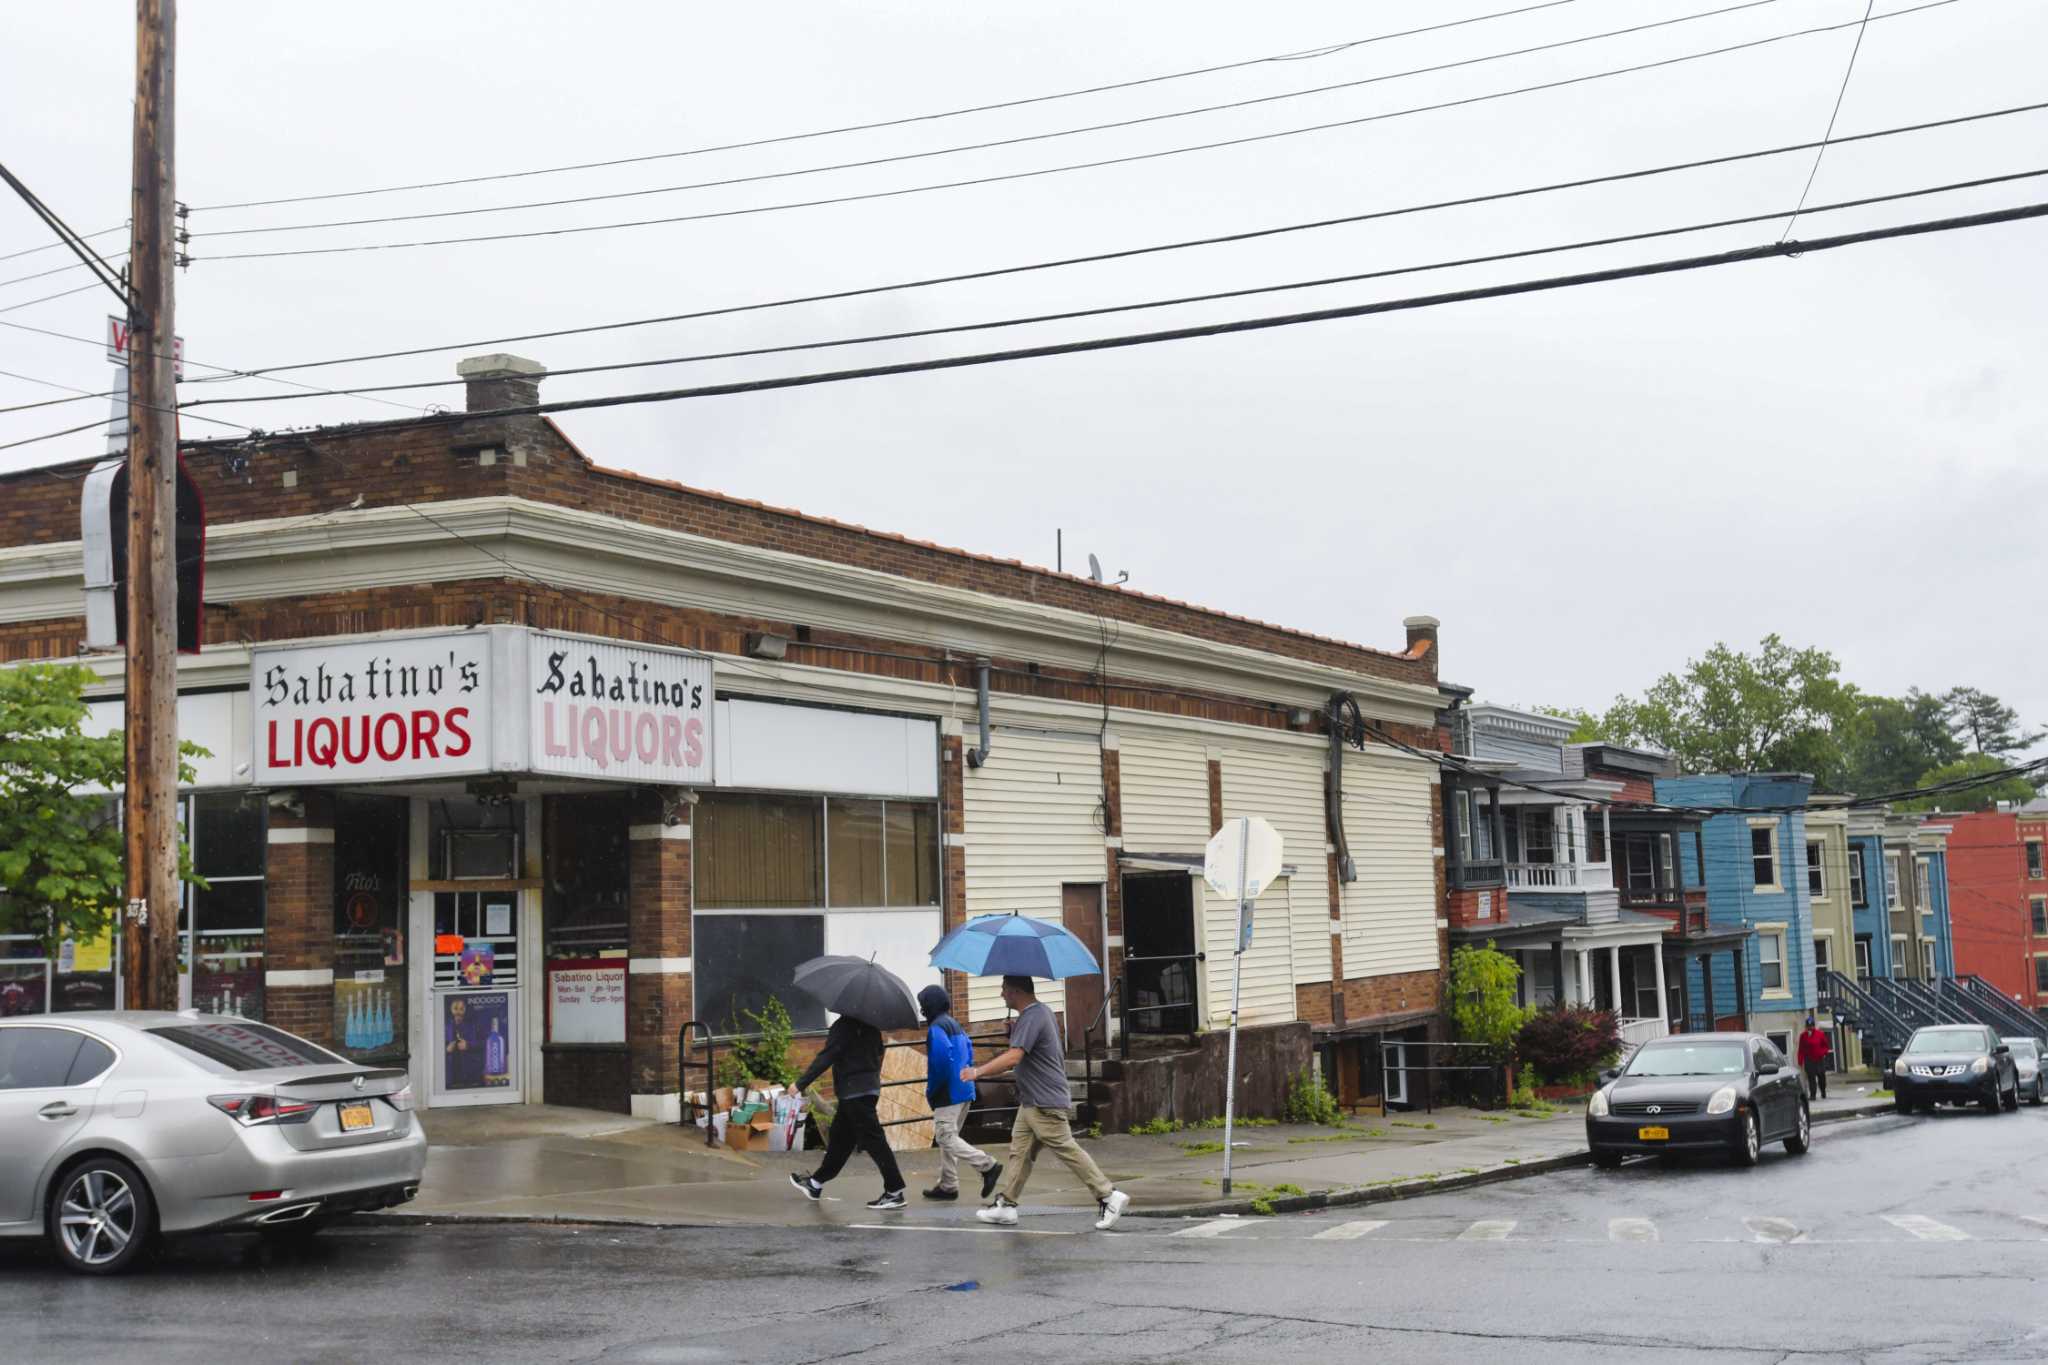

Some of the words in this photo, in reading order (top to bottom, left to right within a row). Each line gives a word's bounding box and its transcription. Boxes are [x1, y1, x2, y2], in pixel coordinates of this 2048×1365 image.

[262, 651, 479, 706] Sabatino's
[537, 651, 702, 709] Sabatino's
[268, 707, 471, 769] LIQUORS
[543, 701, 704, 769] LIQUORS
[554, 973, 592, 982] Sabatino
[596, 972, 624, 983] Liquor
